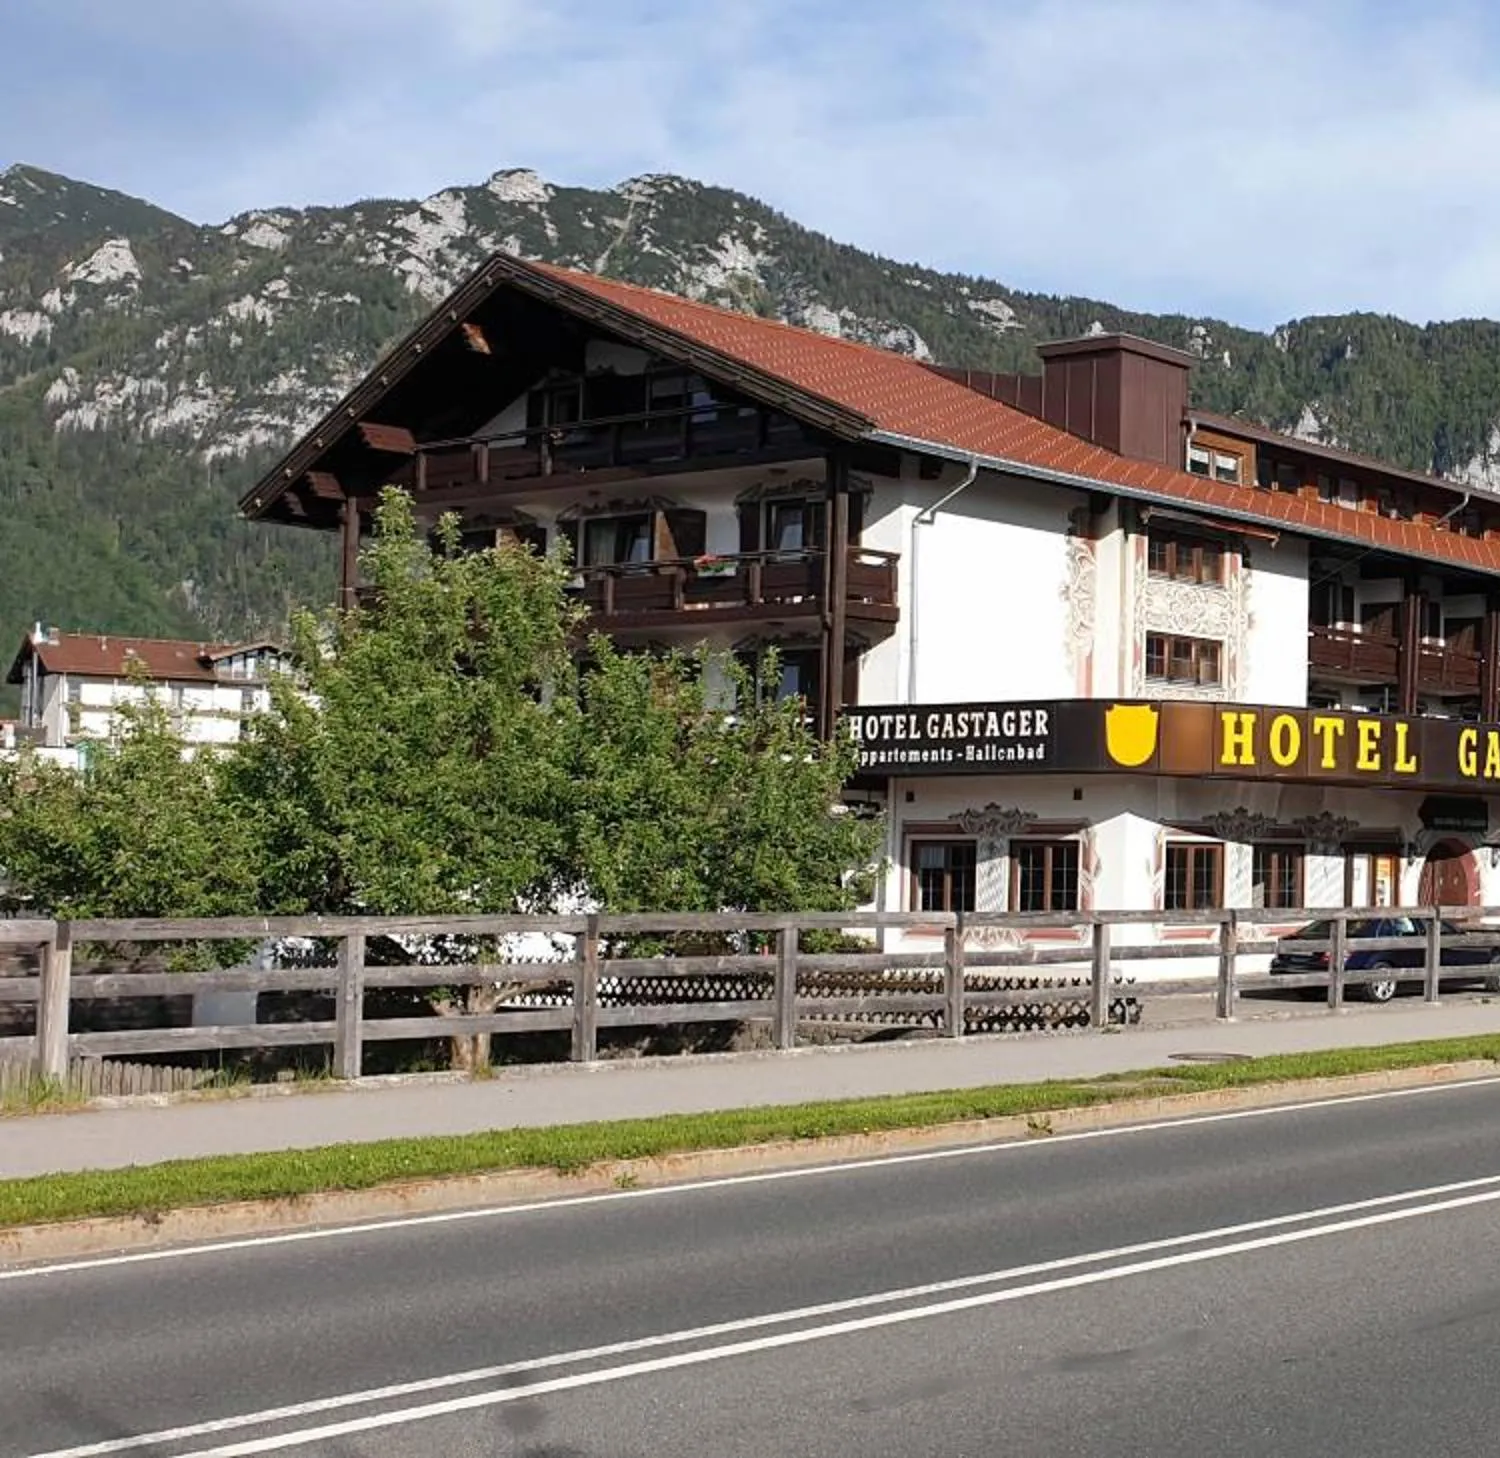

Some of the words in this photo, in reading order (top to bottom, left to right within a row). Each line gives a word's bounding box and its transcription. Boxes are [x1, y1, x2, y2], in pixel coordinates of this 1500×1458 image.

[850, 714, 921, 739] HOTEL
[927, 710, 1049, 739] GASTAGER
[965, 743, 1045, 761] Hallenbad
[1221, 712, 1417, 773] HOTEL
